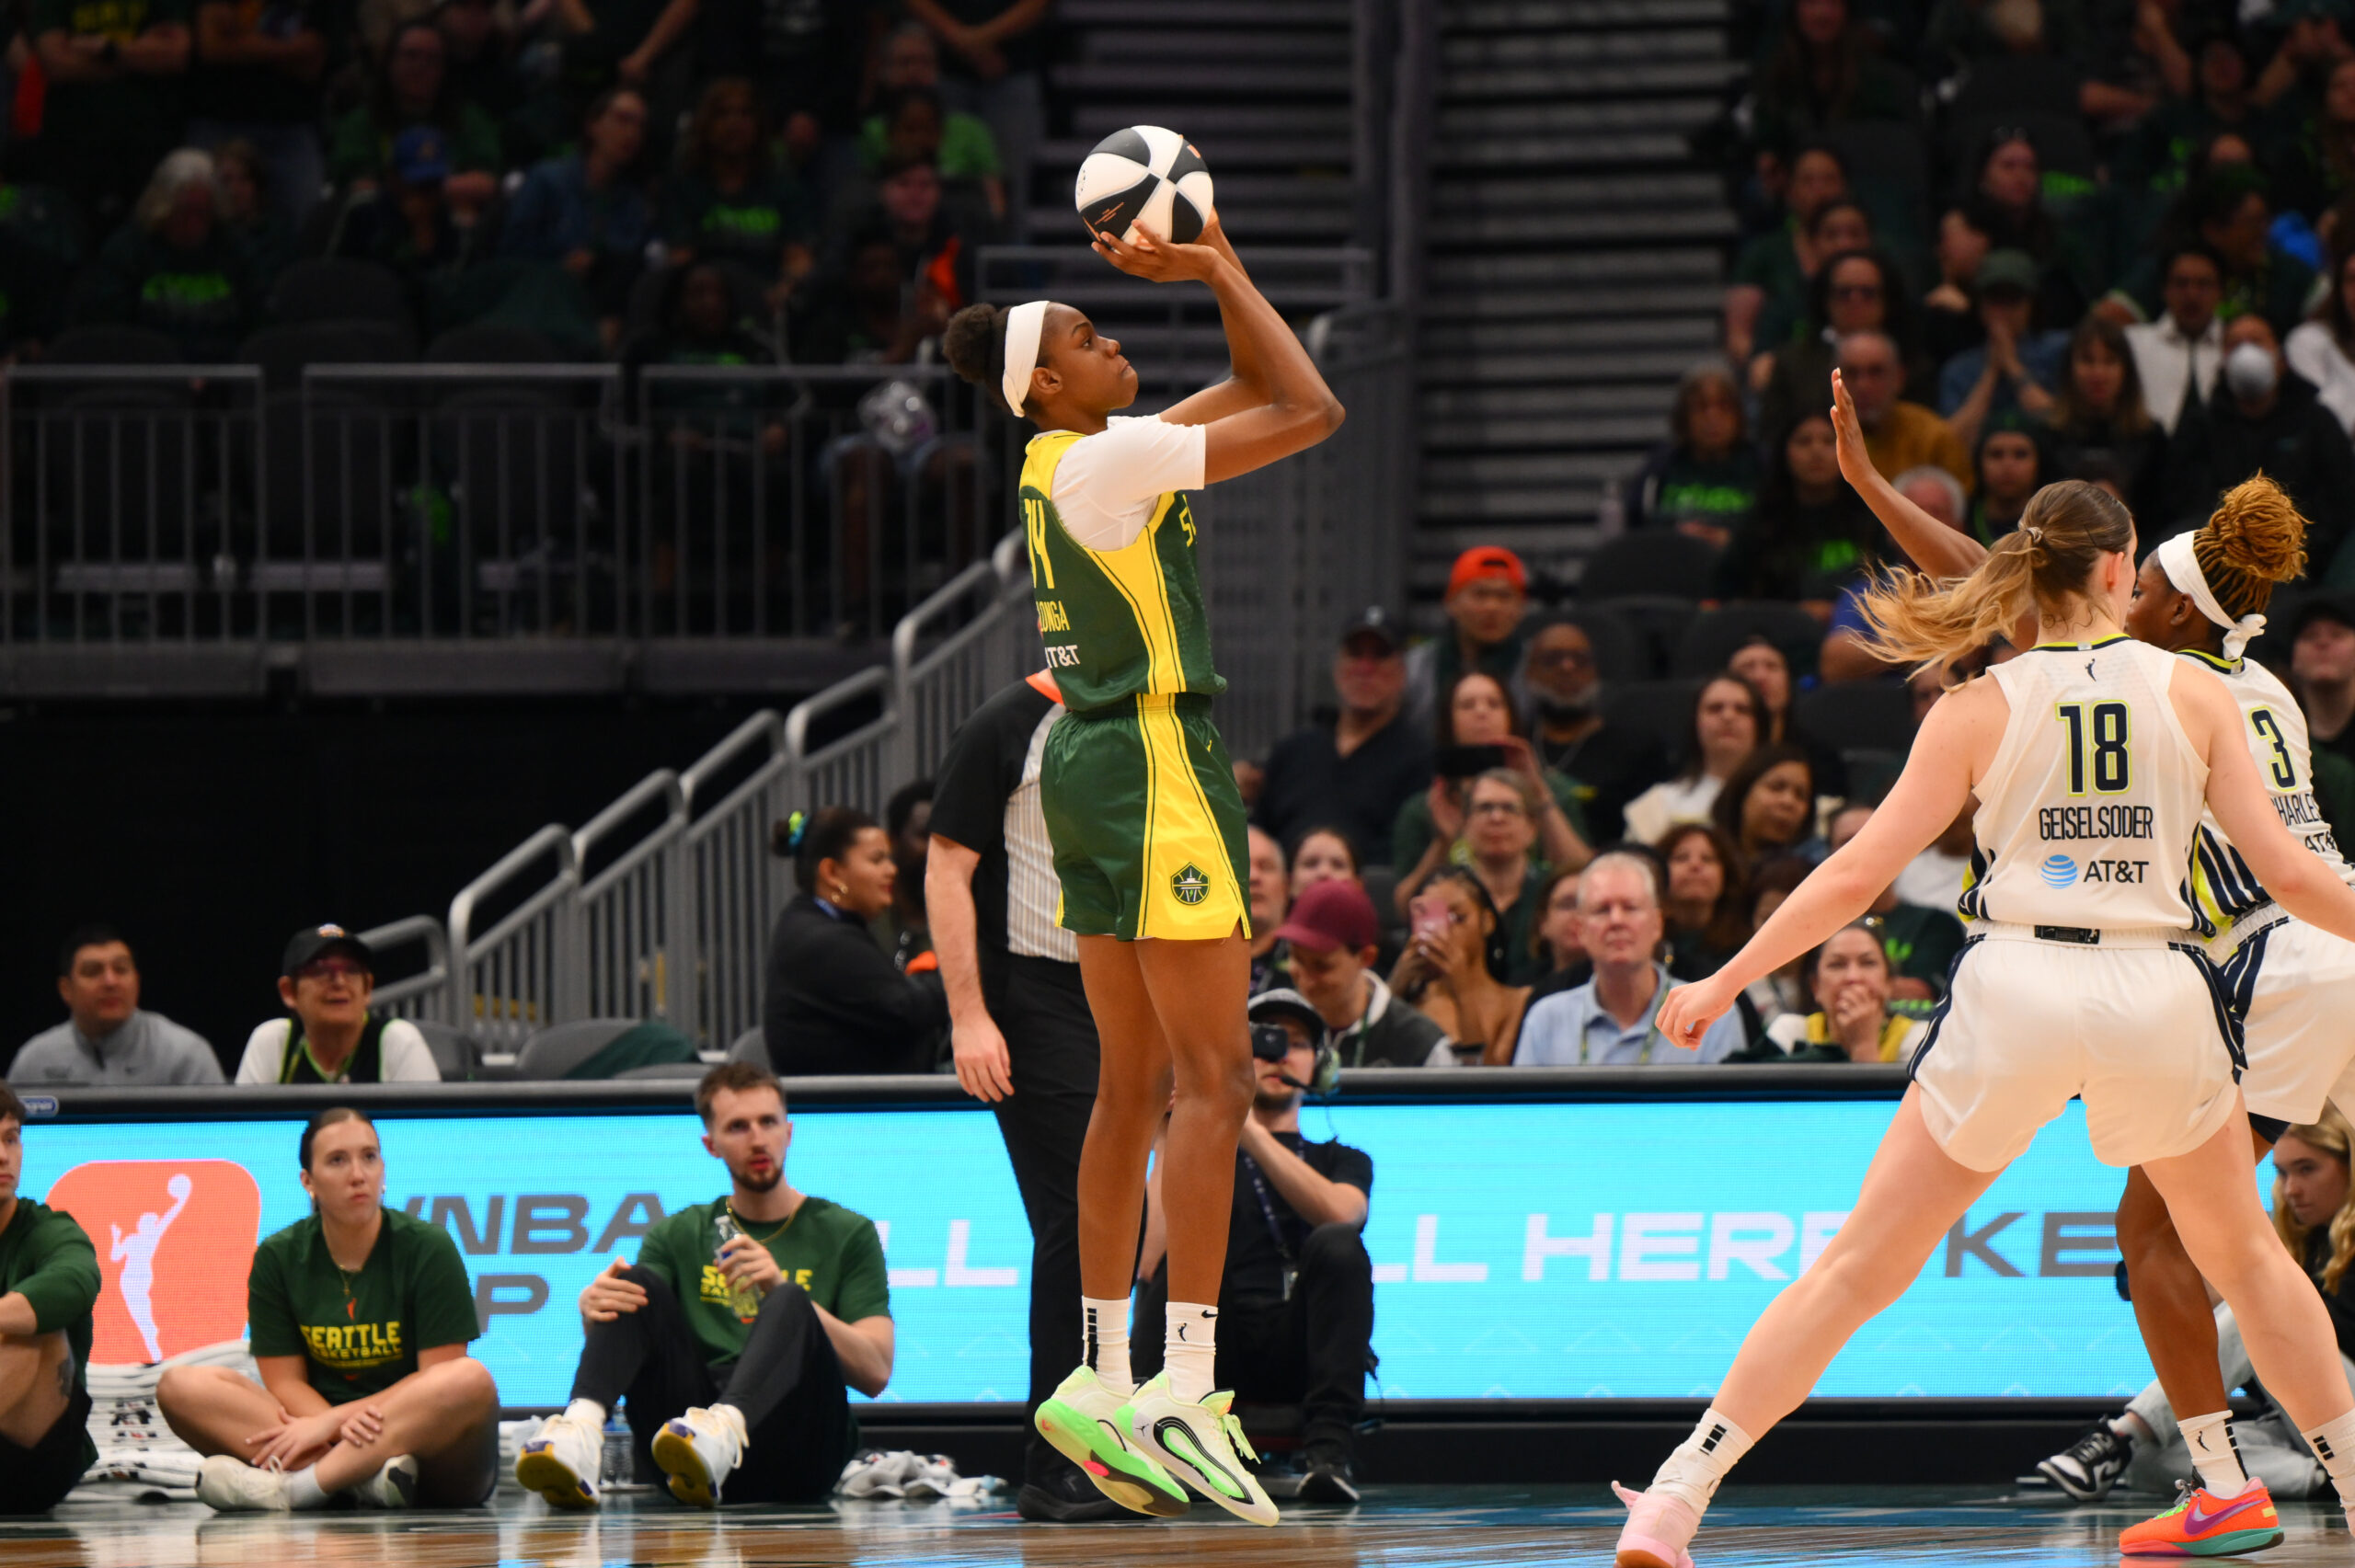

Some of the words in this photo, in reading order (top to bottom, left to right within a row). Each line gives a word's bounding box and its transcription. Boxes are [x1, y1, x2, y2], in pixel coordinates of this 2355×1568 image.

[2055, 700, 2131, 796] 18
[2248, 705, 2299, 793] 3
[2039, 805, 2154, 841] GEISELSODER
[2271, 793, 2322, 826] HARLE
[2083, 859, 2150, 884] AT&T
[404, 1193, 669, 1255] NBA
[300, 1321, 402, 1350] SEATTLE
